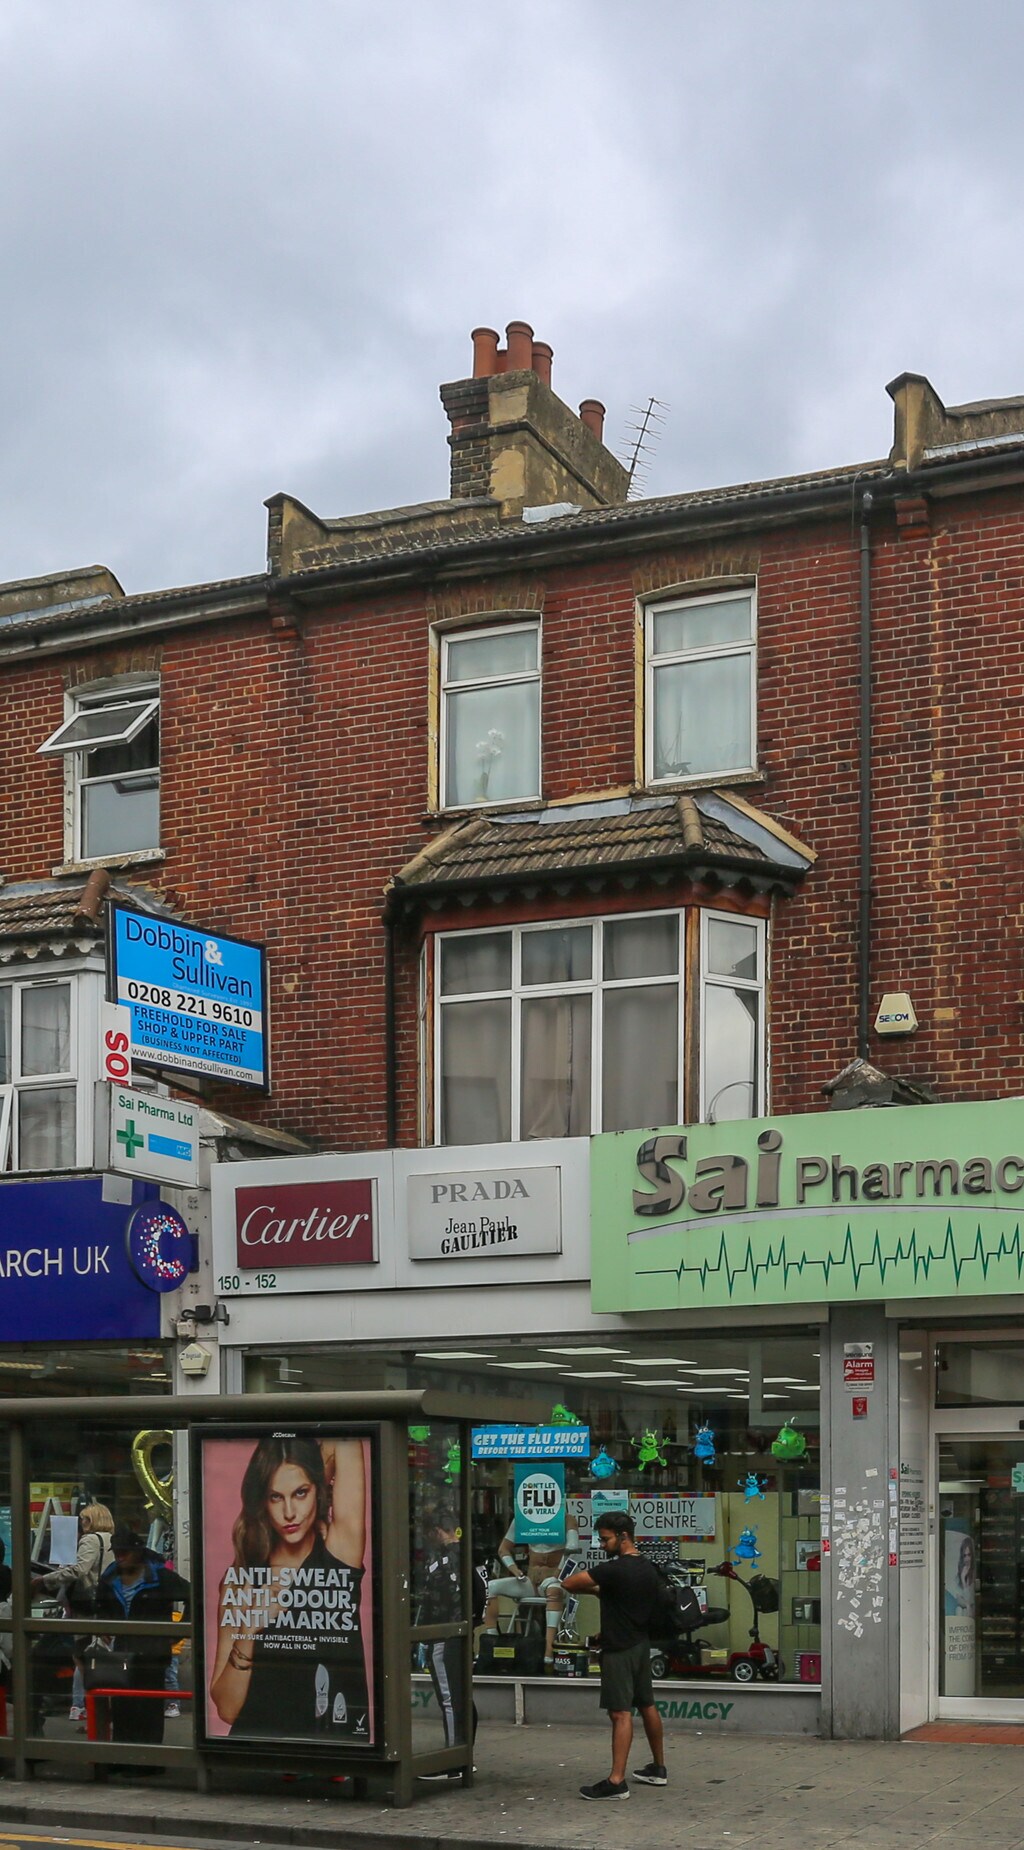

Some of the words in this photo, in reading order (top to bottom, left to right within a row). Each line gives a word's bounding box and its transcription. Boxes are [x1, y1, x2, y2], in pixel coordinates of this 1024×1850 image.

[172, 957, 252, 998] Sullivan
[128, 982, 171, 1007] 0208
[177, 994, 207, 1016] 221
[213, 1003, 252, 1026] 9610
[134, 1005, 193, 1028] FREEHOLD
[197, 1021, 218, 1035] FOR
[222, 1026, 247, 1042] SALE
[879, 1013, 909, 1023] SECOM
[138, 1020, 167, 1035] SHOP
[171, 1028, 178, 1038] &
[182, 1030, 215, 1047] UPPER
[219, 1039, 244, 1052] PART
[142, 1035, 182, 1052] (BUSINESS
[184, 1044, 200, 1055] NOT
[202, 1049, 241, 1065] AFFECTED)
[131, 1048, 253, 1080] www.dobbinandsullivan.com
[119, 1095, 134, 1110] Sai
[138, 1100, 175, 1121] Pharma
[178, 1112, 193, 1126] Ltd
[631, 1128, 782, 1217] Sai
[431, 1179, 530, 1203] PRADA
[240, 1205, 369, 1247] Cartier
[445, 1217, 476, 1234] Jean
[480, 1216, 509, 1232] Paul
[441, 1225, 518, 1255] GAULTIER
[74, 1246, 110, 1274] UK
[218, 1275, 240, 1290] 150
[255, 1274, 276, 1288] 152
[474, 1434, 497, 1446] GET
[500, 1434, 525, 1445] THE
[528, 1433, 551, 1444] FLU
[554, 1432, 588, 1444] SHOT
[478, 1447, 508, 1455] BEFORE
[510, 1446, 526, 1454] THE
[566, 1445, 583, 1453] YOU
[523, 1490, 555, 1507] FLU
[631, 1500, 695, 1513] MOBILITY
[643, 1515, 696, 1528] CENTRE
[224, 1567, 354, 1591] ANTI-SWEAT,
[222, 1588, 356, 1613] ANTI-ODOUR,
[220, 1609, 358, 1631] ANTI-MARKS.
